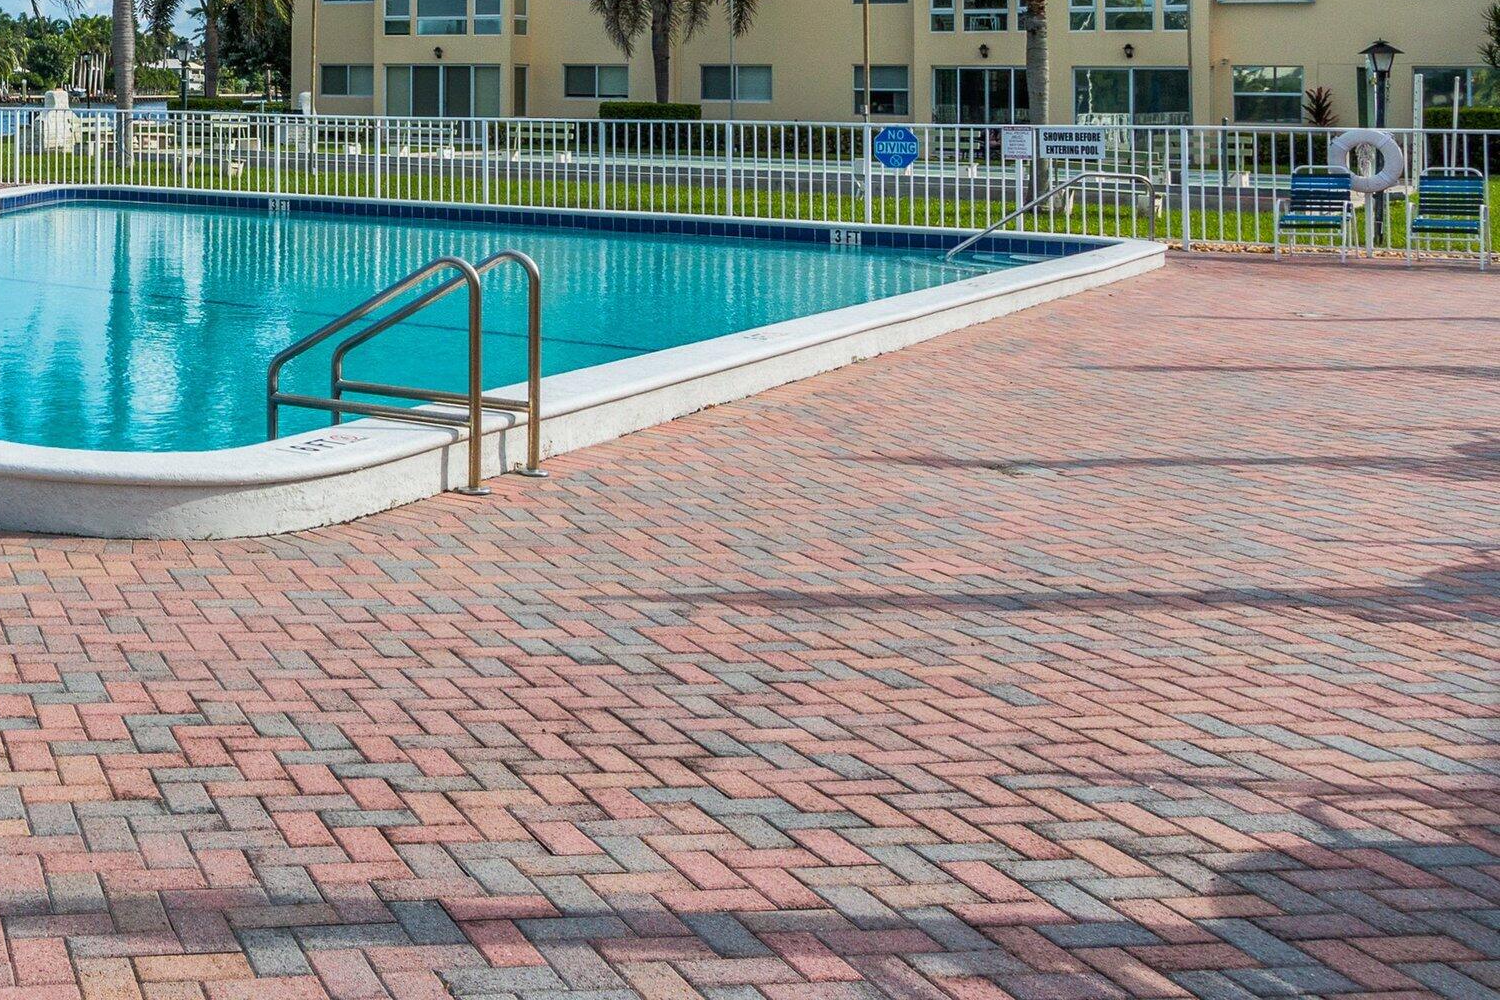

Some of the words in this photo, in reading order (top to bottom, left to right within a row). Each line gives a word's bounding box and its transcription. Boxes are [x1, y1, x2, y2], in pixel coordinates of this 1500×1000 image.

[887, 129, 905, 140] NO
[1043, 132, 1073, 142] SHOWER
[1075, 132, 1101, 142] BEFORE
[877, 142, 916, 153] DIVING
[1046, 145, 1080, 155] ENTERING
[1080, 145, 1100, 155] POOL
[835, 229, 842, 243] 3
[846, 230, 860, 244] FT
